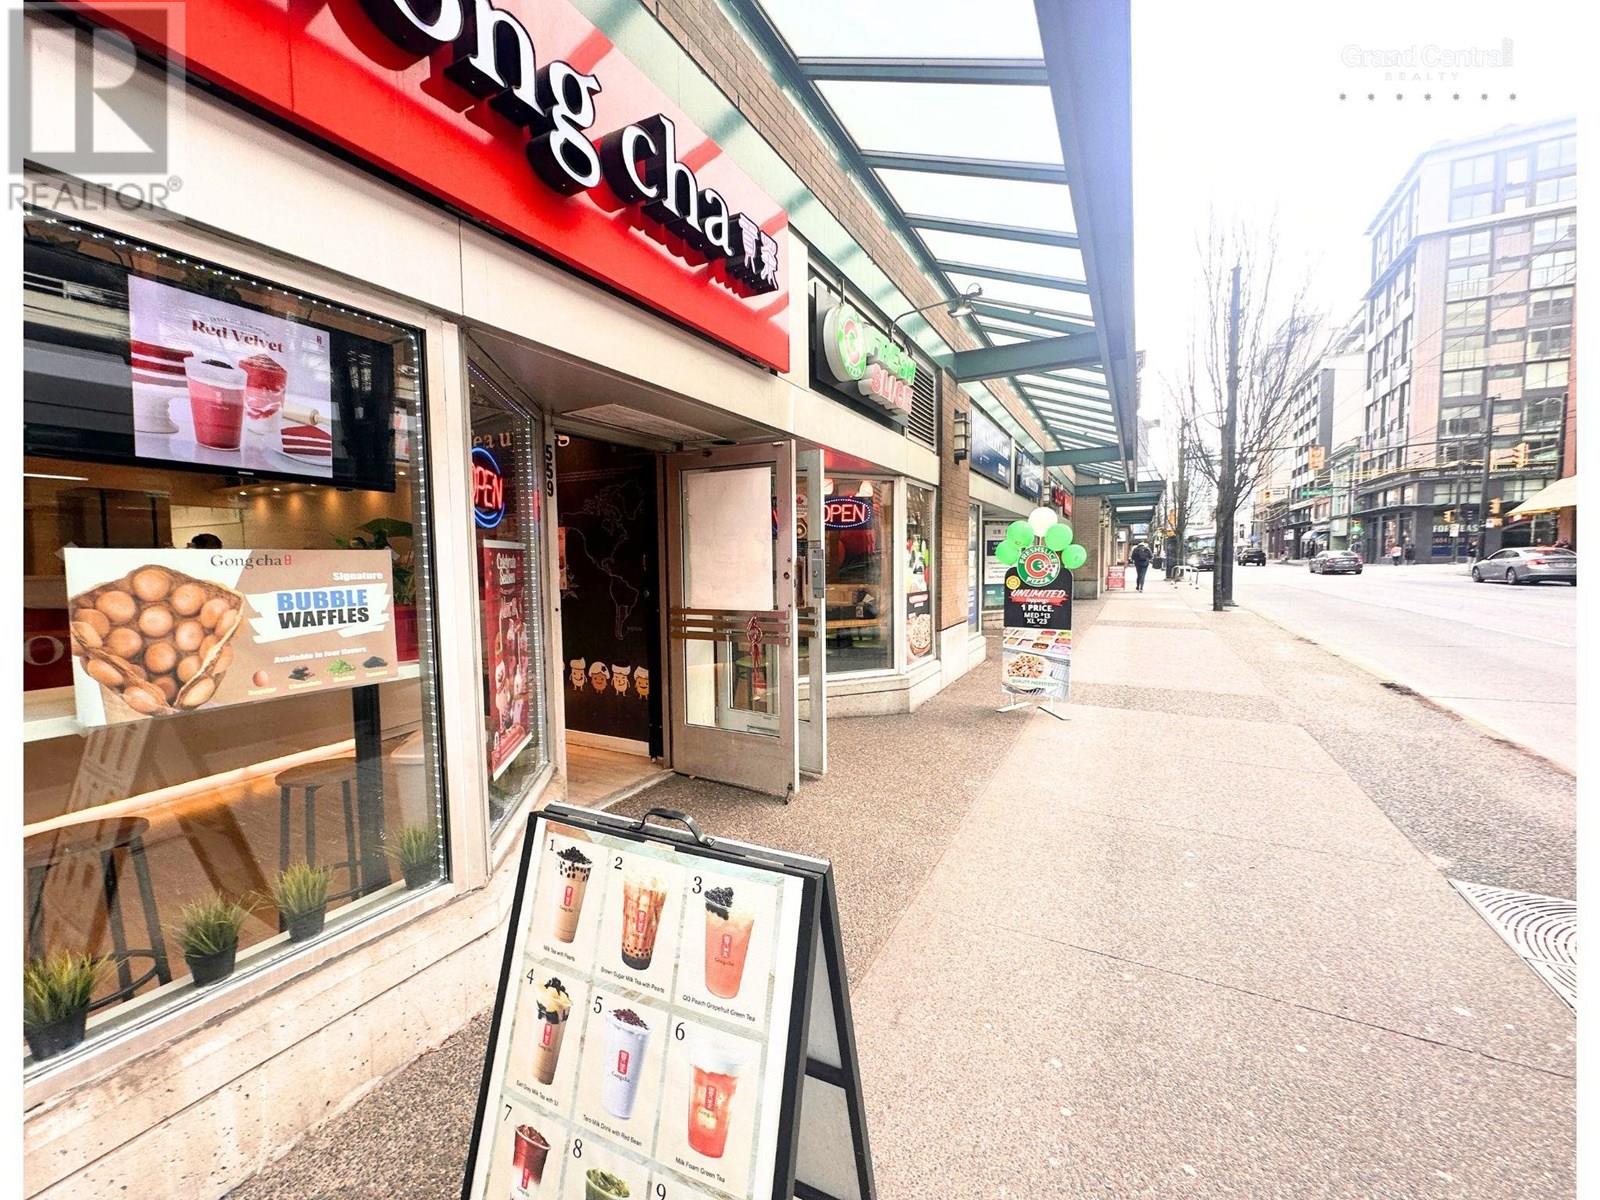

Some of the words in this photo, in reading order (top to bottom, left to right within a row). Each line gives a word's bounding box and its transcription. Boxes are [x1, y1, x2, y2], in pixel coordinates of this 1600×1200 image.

[384, 0, 603, 188] ong
[621, 115, 734, 256] cha
[192, 319, 228, 340] Red
[231, 329, 284, 353] Velvet
[545, 444, 554, 497] 559
[210, 554, 254, 569] Gong
[256, 554, 282, 566] cha
[276, 589, 369, 611] BUBBLE
[1010, 589, 1066, 598] UNLIMITED
[277, 607, 370, 629] WAFFLES
[549, 839, 554, 851] 1
[614, 857, 623, 870] 2
[692, 876, 703, 894] 3
[526, 968, 534, 984] 4
[593, 996, 603, 1014] 5
[691, 997, 706, 1006] Peach
[706, 1002, 729, 1014] Grapefruit
[730, 1009, 745, 1018] Green
[746, 1013, 756, 1022] Tea
[675, 1021, 685, 1041] 6
[504, 1104, 513, 1121] 7
[621, 1132, 630, 1142] Red
[573, 1138, 583, 1158] 8
[675, 1156, 685, 1167] Milk
[685, 1161, 700, 1172] Foam
[700, 1167, 716, 1179] Green
[716, 1173, 725, 1183] Tea
[656, 1183, 666, 1200] 9
